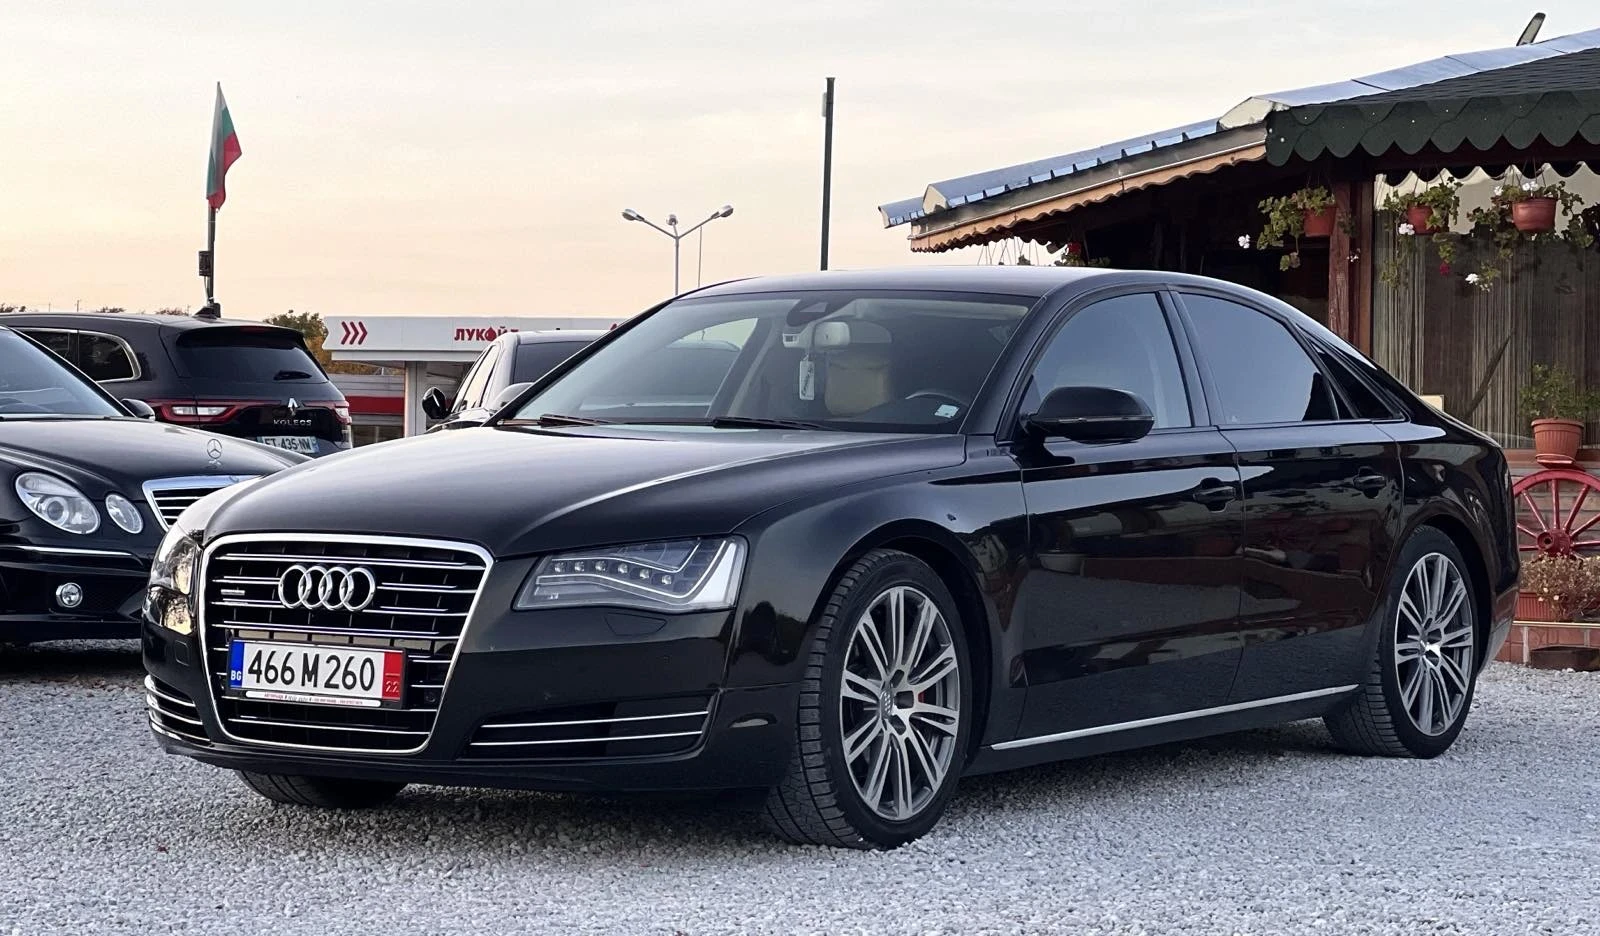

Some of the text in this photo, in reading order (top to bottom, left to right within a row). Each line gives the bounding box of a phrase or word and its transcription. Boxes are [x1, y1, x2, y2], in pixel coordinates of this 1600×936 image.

[230, 670, 242, 681] BG
[248, 649, 375, 691] 466 M 260
[386, 680, 400, 693] 22
